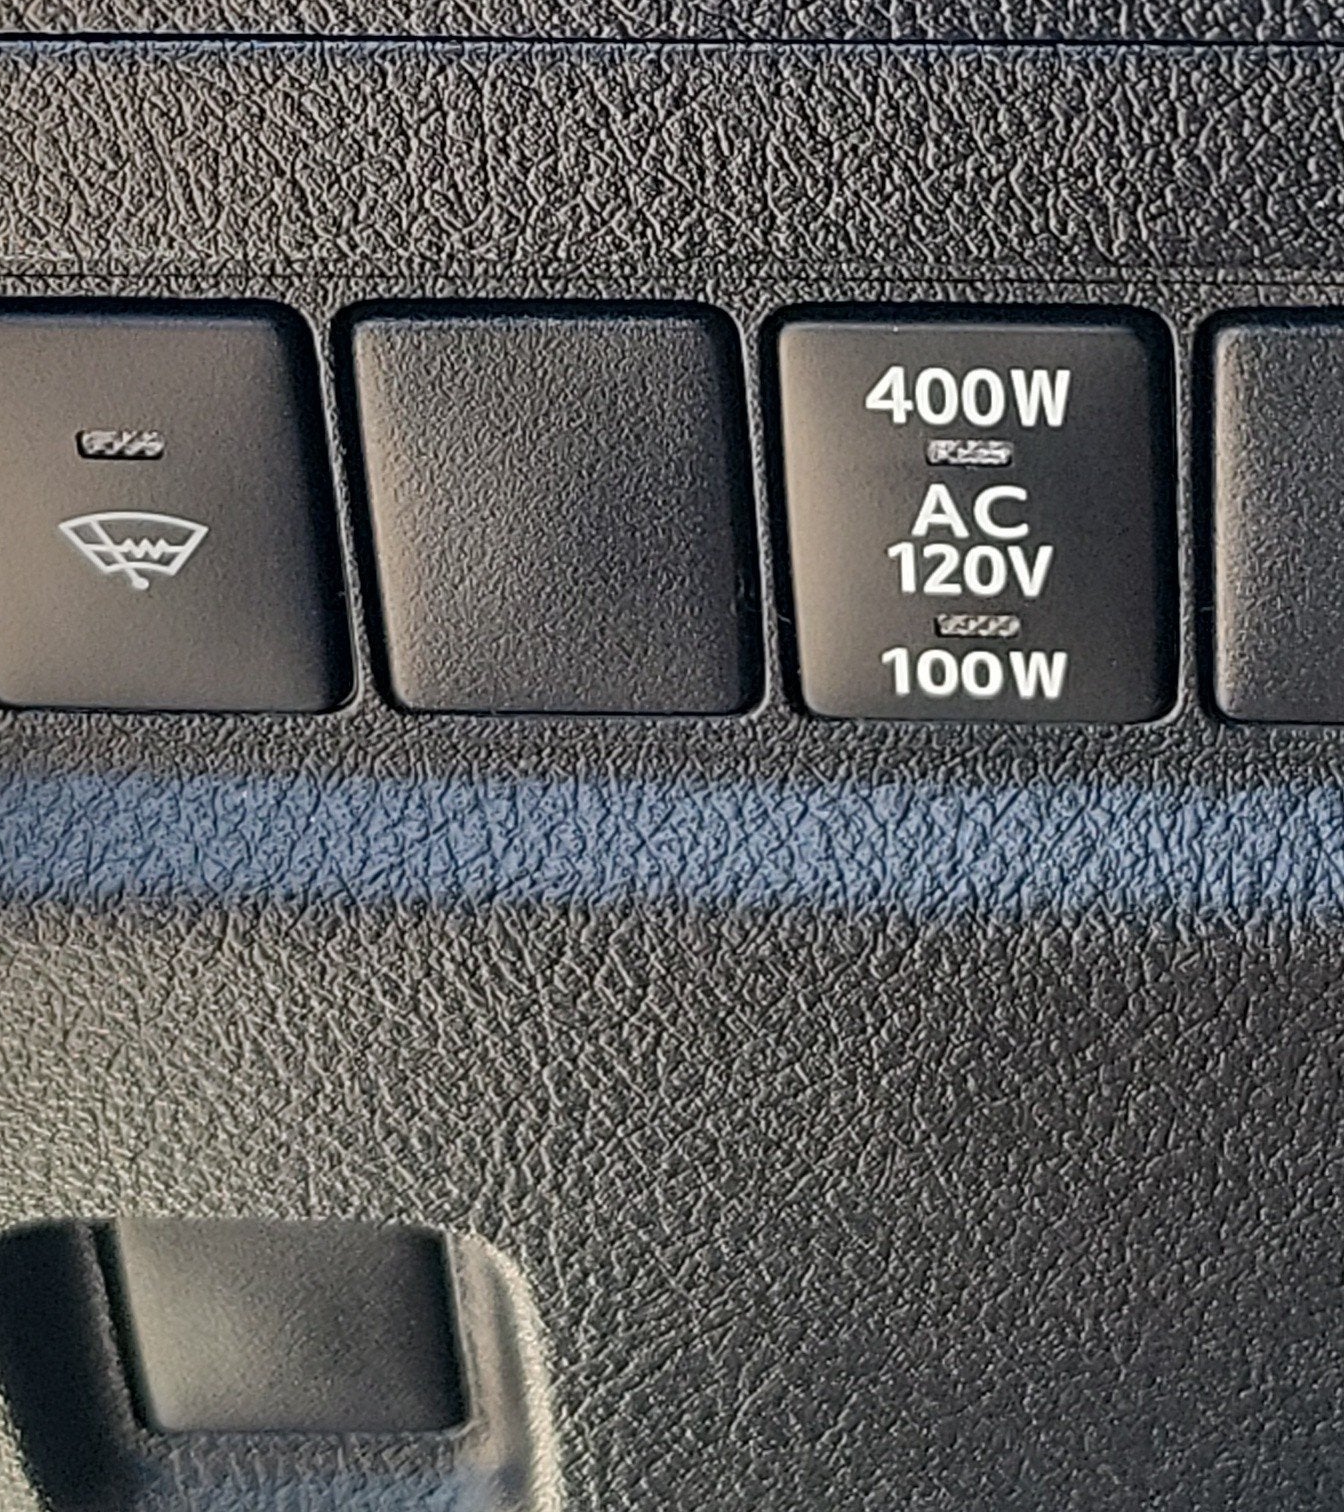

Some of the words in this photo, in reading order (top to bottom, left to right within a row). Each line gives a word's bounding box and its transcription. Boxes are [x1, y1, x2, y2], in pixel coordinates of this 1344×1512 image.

[864, 365, 1072, 428] 400W
[910, 482, 1030, 540] AC
[886, 540, 1054, 598] 120V
[880, 646, 1068, 700] 100W
